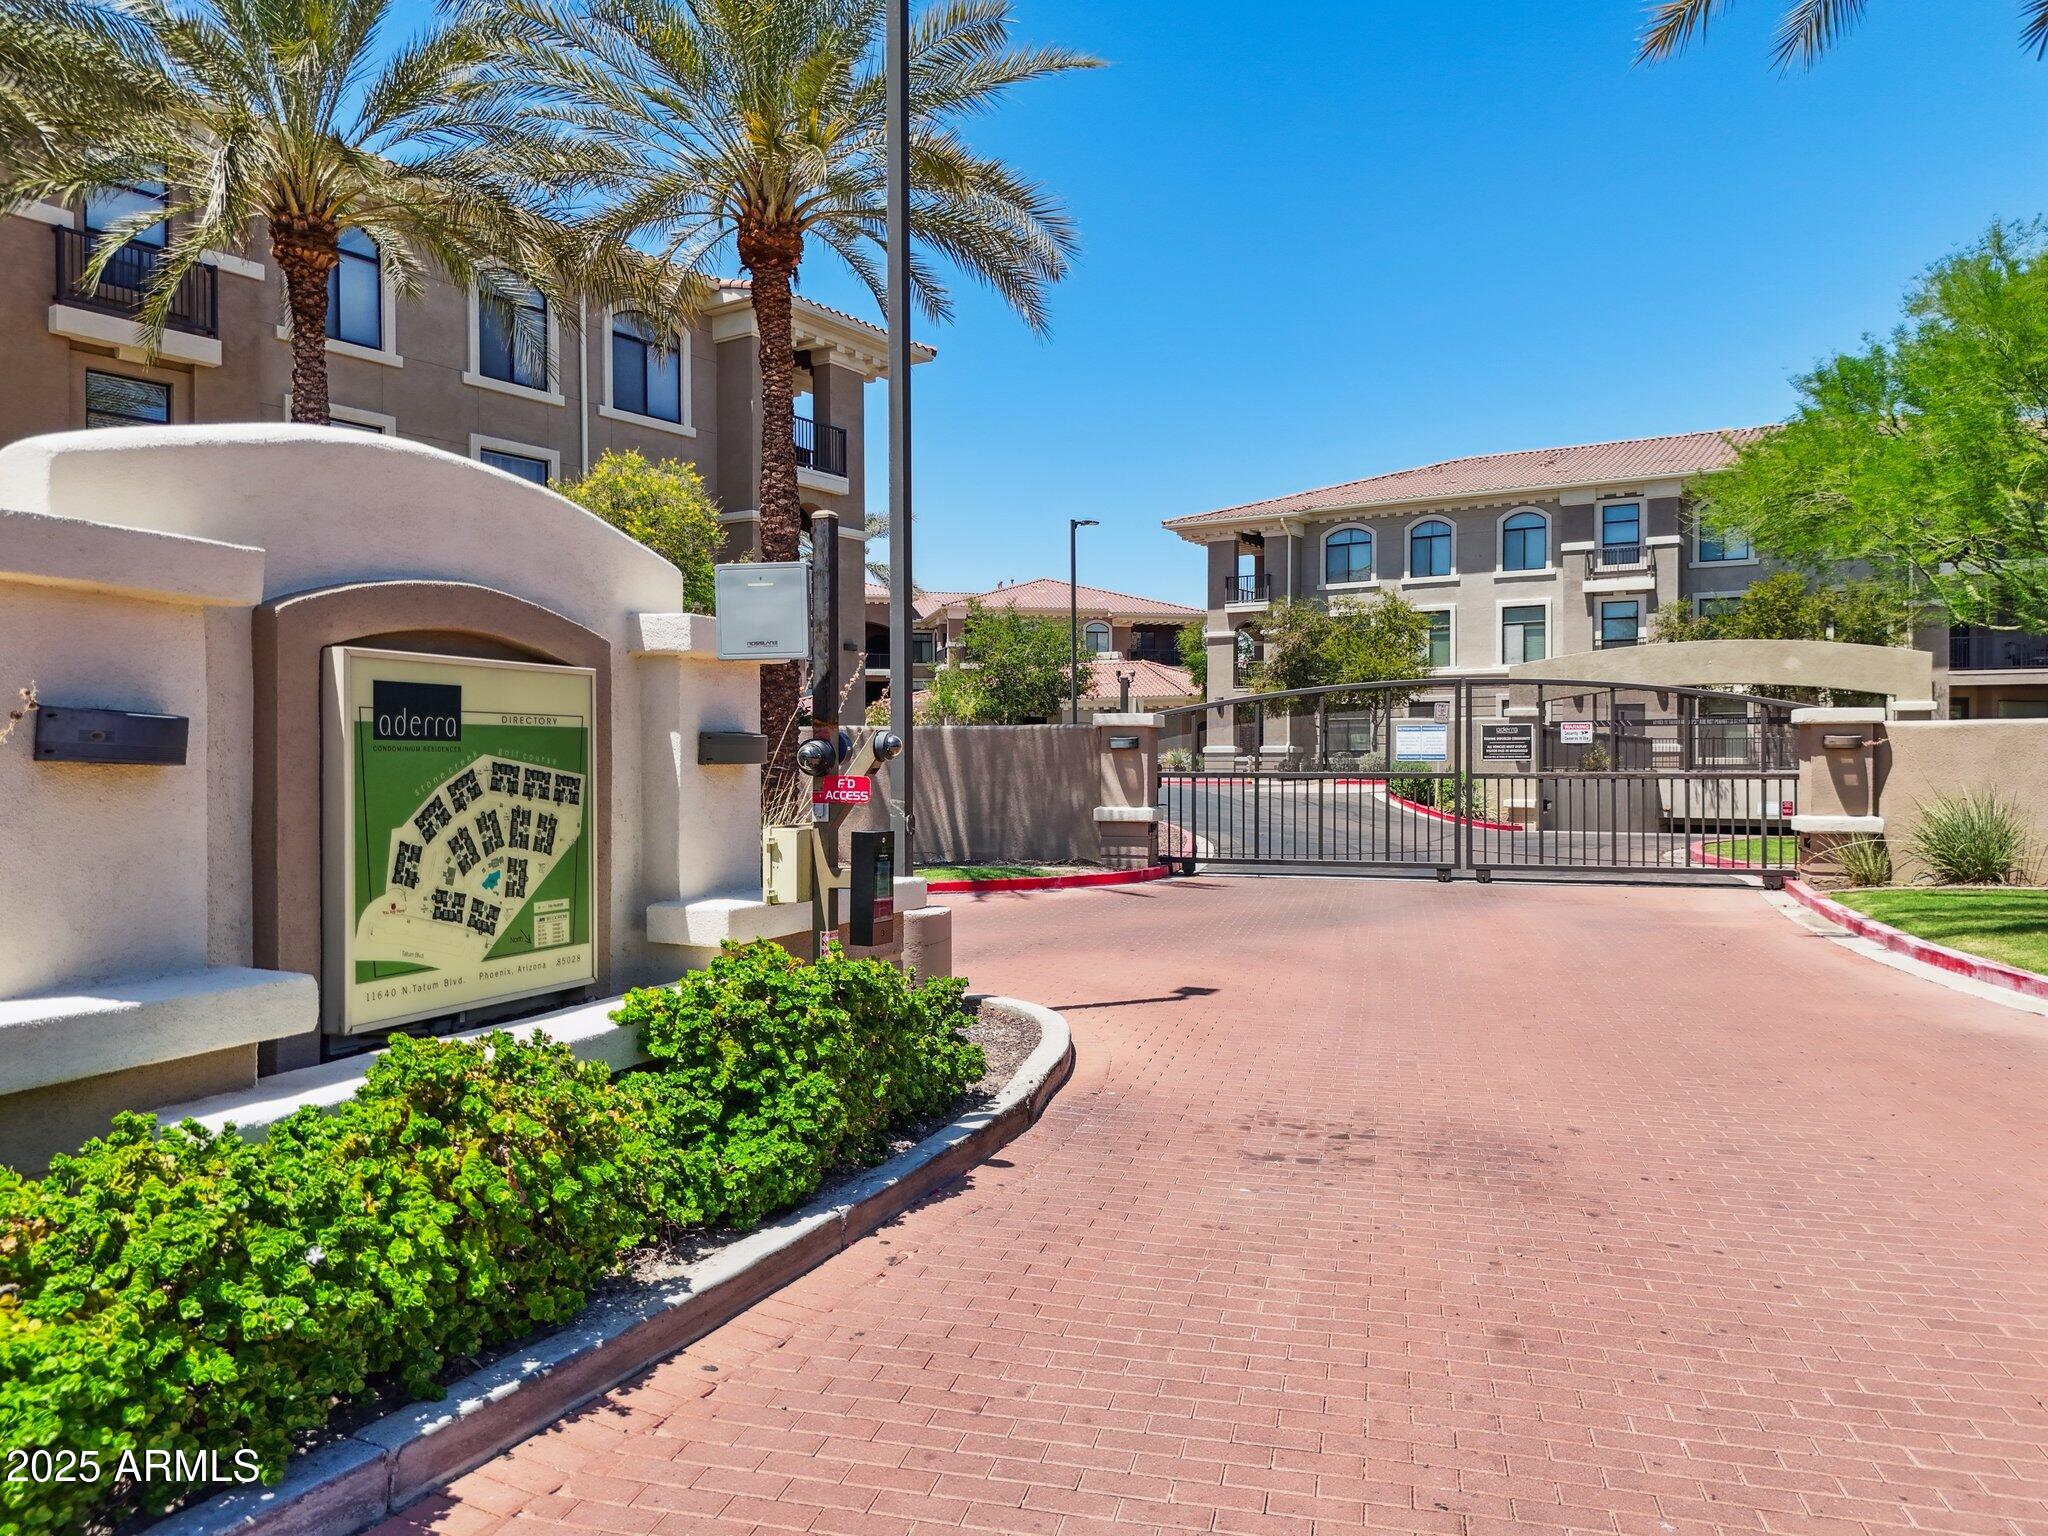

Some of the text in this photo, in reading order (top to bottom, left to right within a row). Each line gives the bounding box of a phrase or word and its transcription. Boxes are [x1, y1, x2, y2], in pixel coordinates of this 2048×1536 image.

[378, 707, 458, 738] aderra
[501, 715, 559, 727] DIRECTORY
[372, 745, 462, 753] CONDOMINIUM RESIDENCES
[824, 790, 869, 801] ACCESS
[366, 988, 397, 1002] 11640
[412, 982, 439, 993] Tatum
[443, 976, 466, 988] Blvd.
[479, 968, 514, 981] Phoenix,
[517, 962, 547, 973] Arizona
